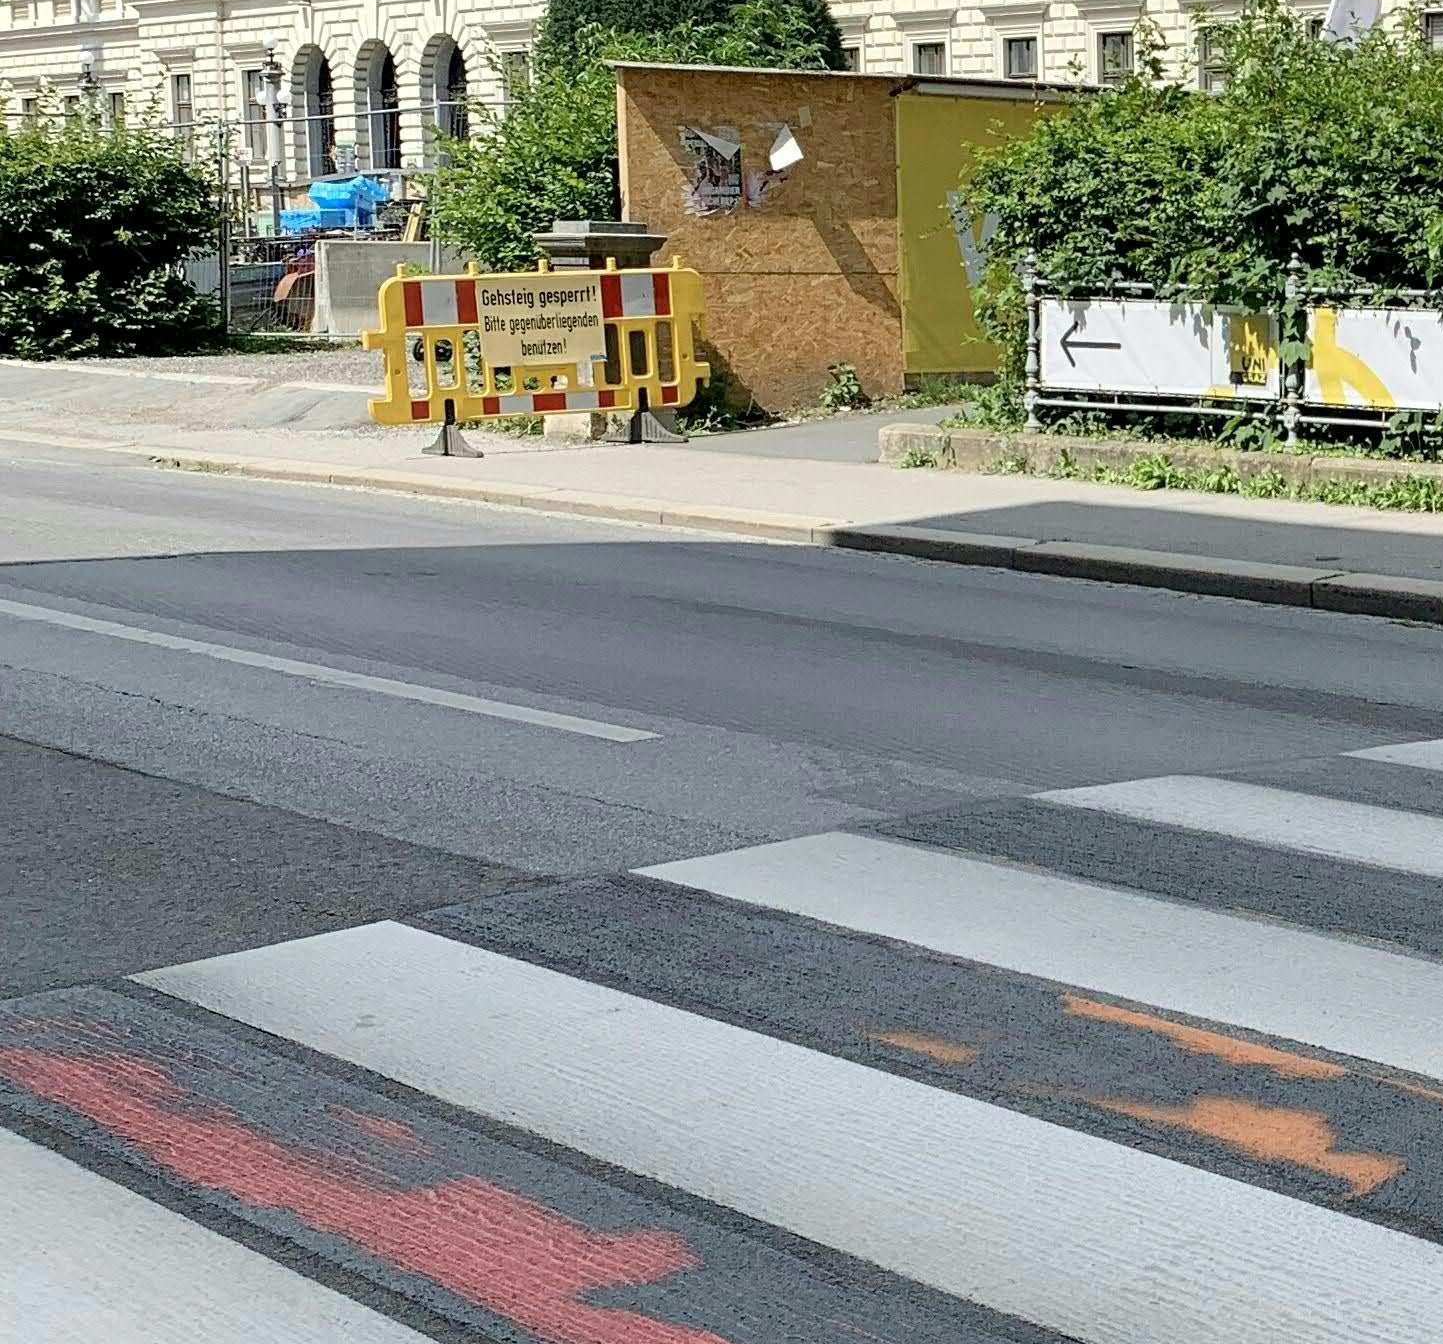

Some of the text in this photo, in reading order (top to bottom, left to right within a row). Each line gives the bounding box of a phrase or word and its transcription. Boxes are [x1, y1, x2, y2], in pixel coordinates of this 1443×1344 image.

[481, 285, 597, 308] Gehsteig gesperrt!
[484, 311, 599, 335] Bitte gegenüberliegenden
[520, 338, 567, 356] benützen!
[1241, 356, 1265, 372] UNI
